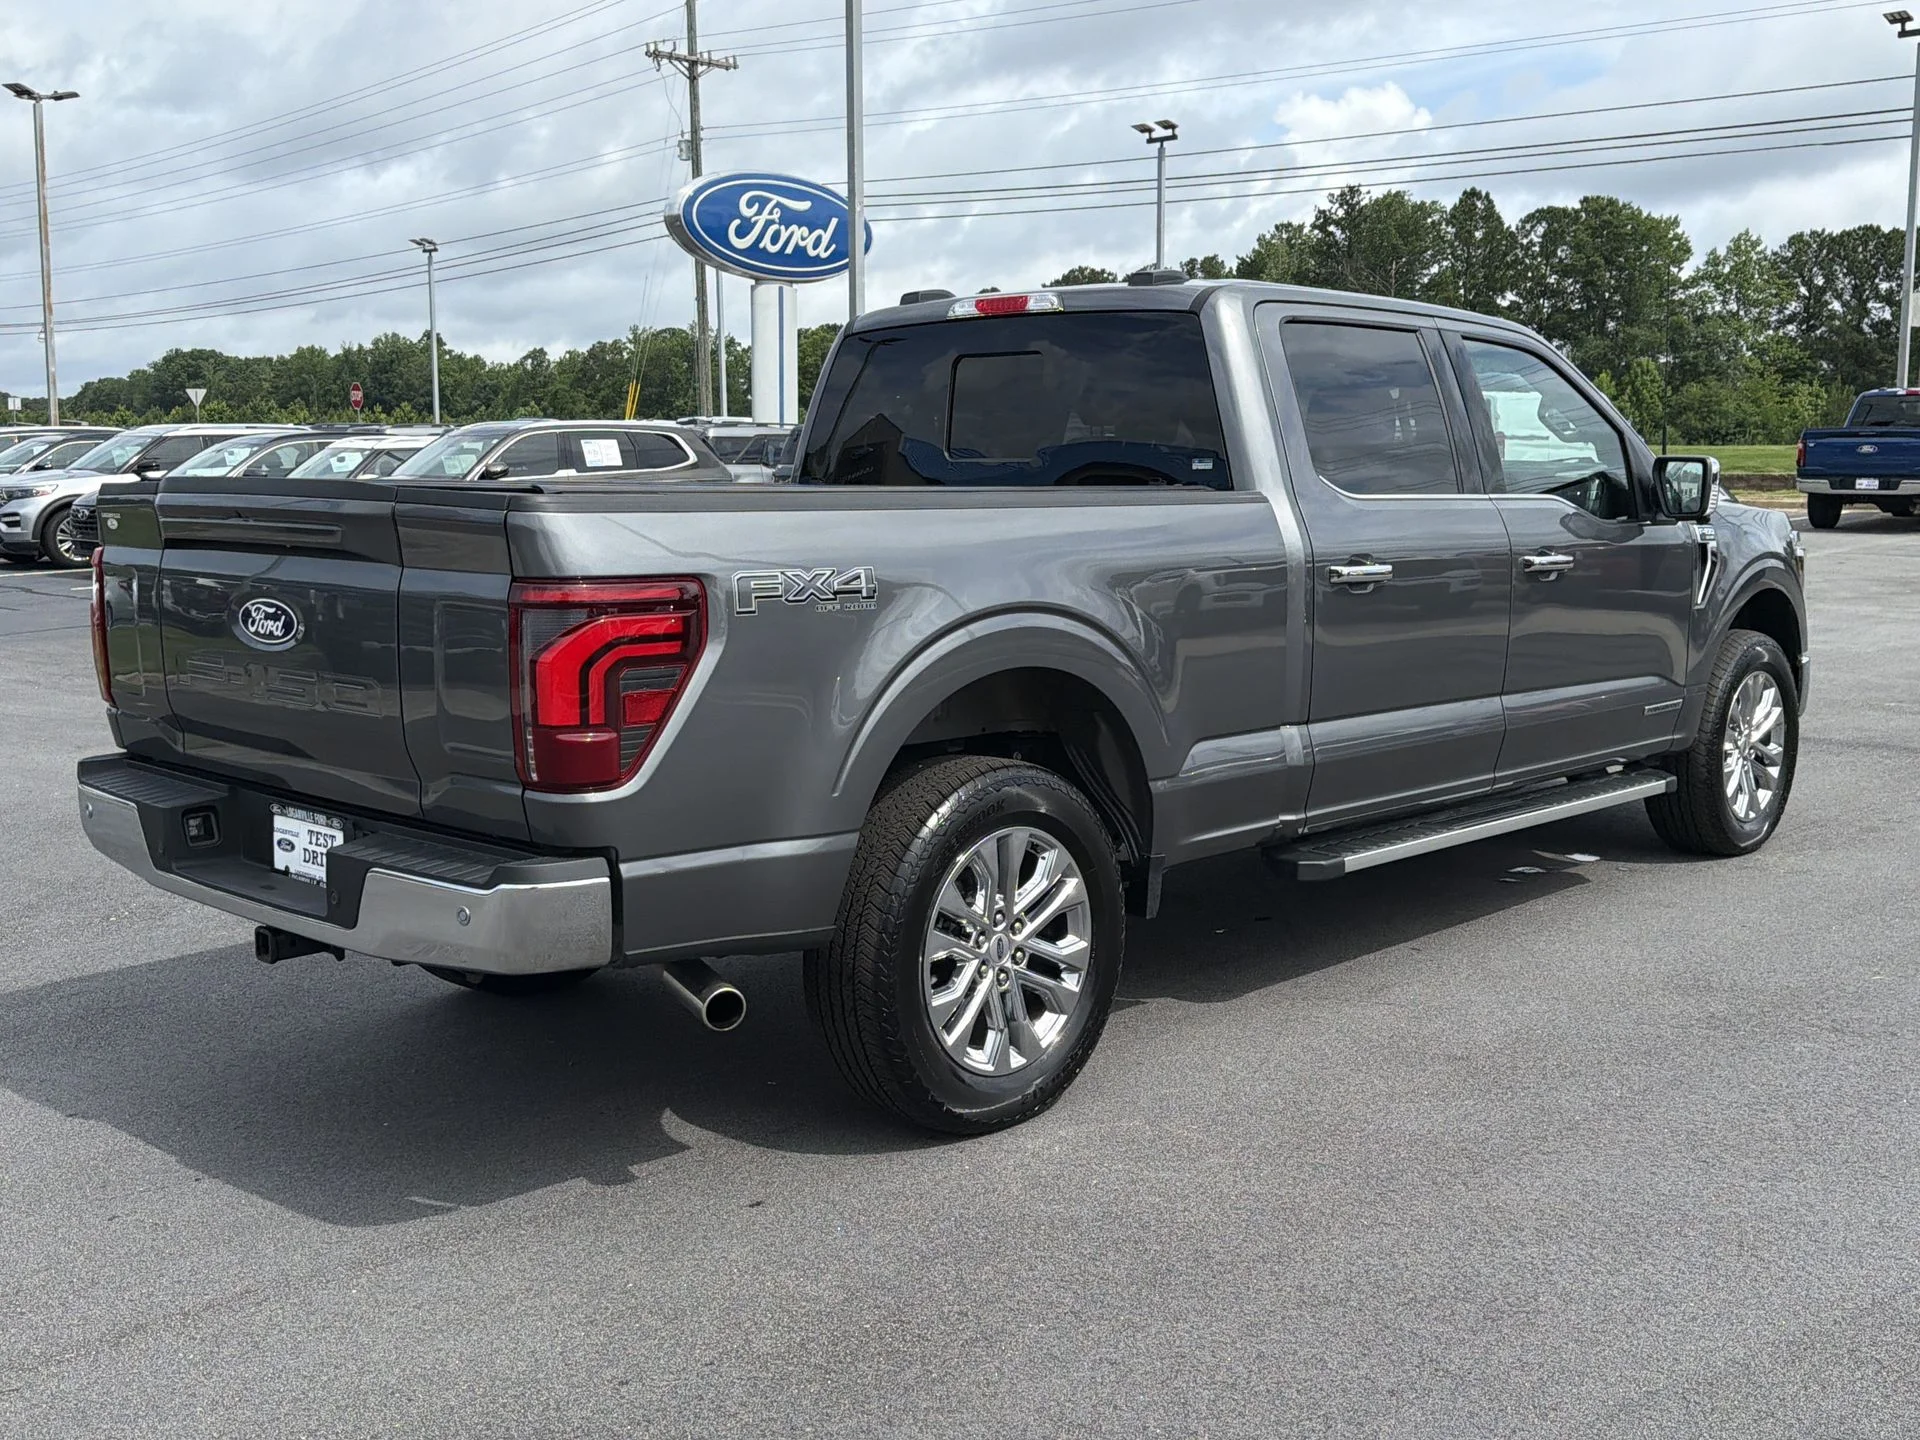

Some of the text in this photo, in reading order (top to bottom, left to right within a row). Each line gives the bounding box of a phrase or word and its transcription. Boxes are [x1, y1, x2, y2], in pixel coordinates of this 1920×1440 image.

[728, 190, 839, 259] Ford
[732, 566, 878, 616] FX4
[815, 602, 877, 612] OFF ROAD
[248, 604, 286, 637] Ford
[176, 653, 386, 719] F-150
[307, 829, 337, 849] TEST
